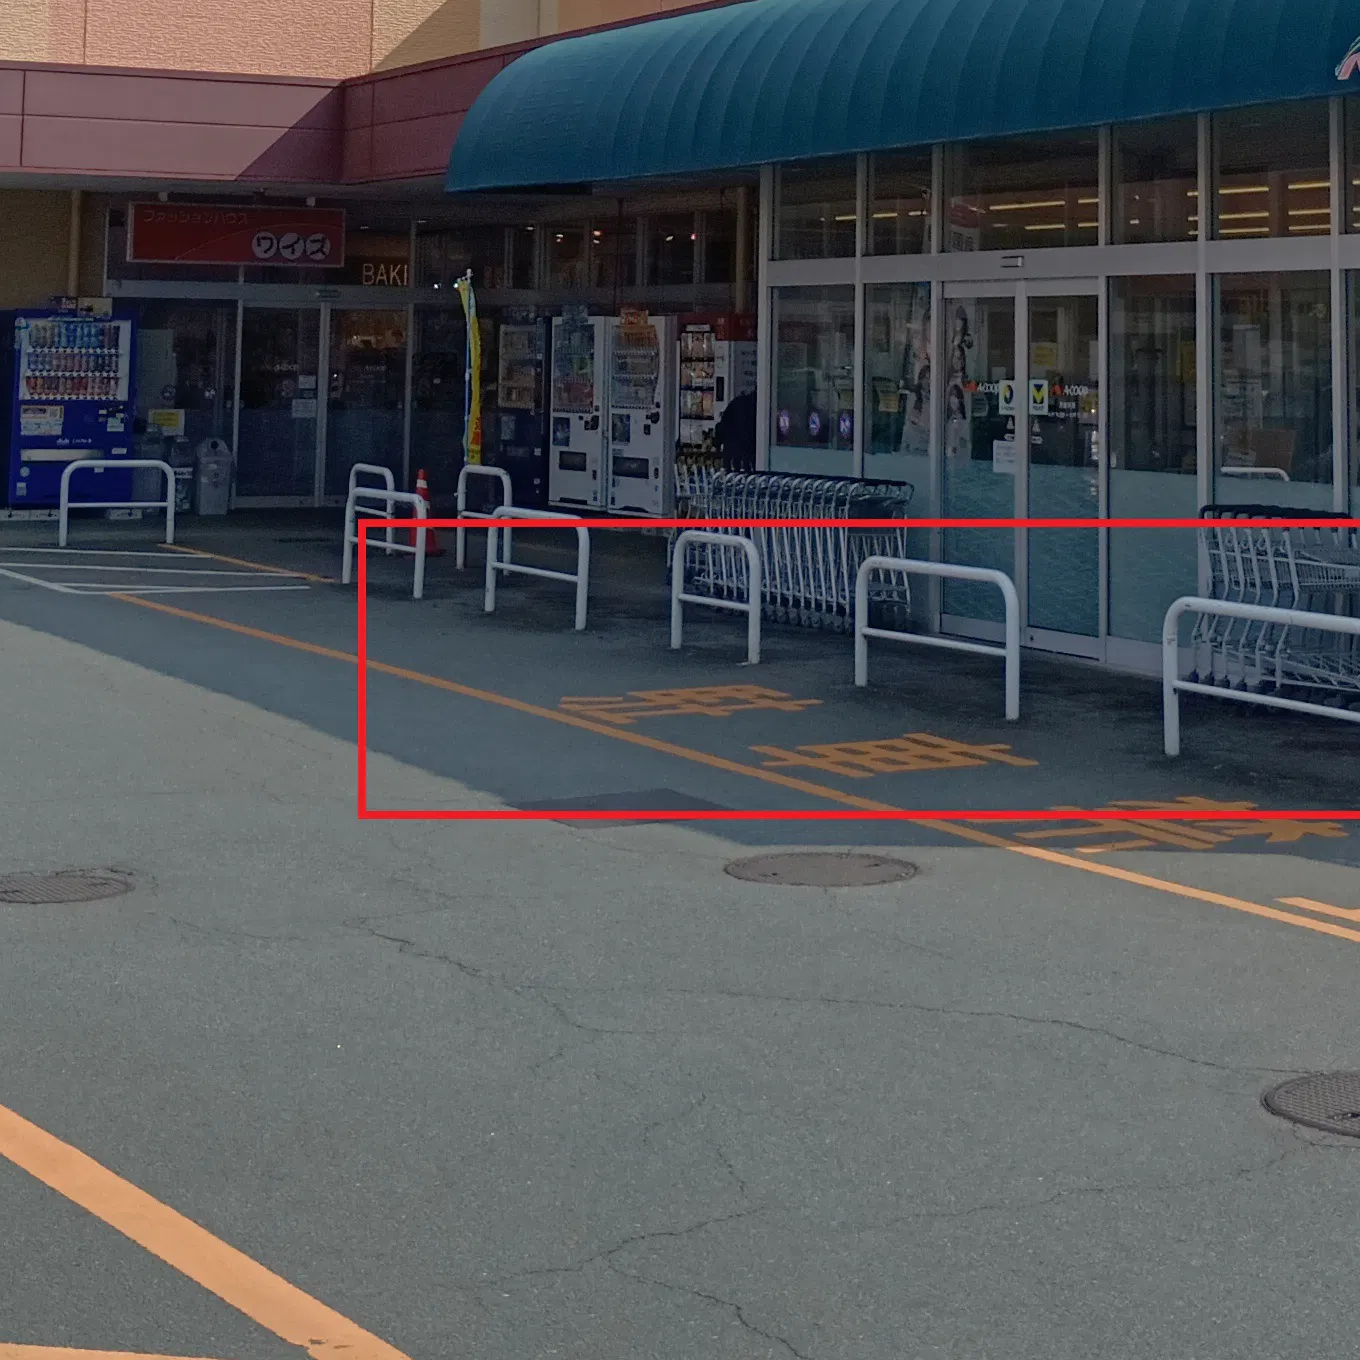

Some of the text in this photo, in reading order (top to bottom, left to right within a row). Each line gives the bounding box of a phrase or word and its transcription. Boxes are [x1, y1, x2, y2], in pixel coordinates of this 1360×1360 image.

[142, 209, 249, 225] ファッションハウス
[253, 232, 330, 260] ワイズ
